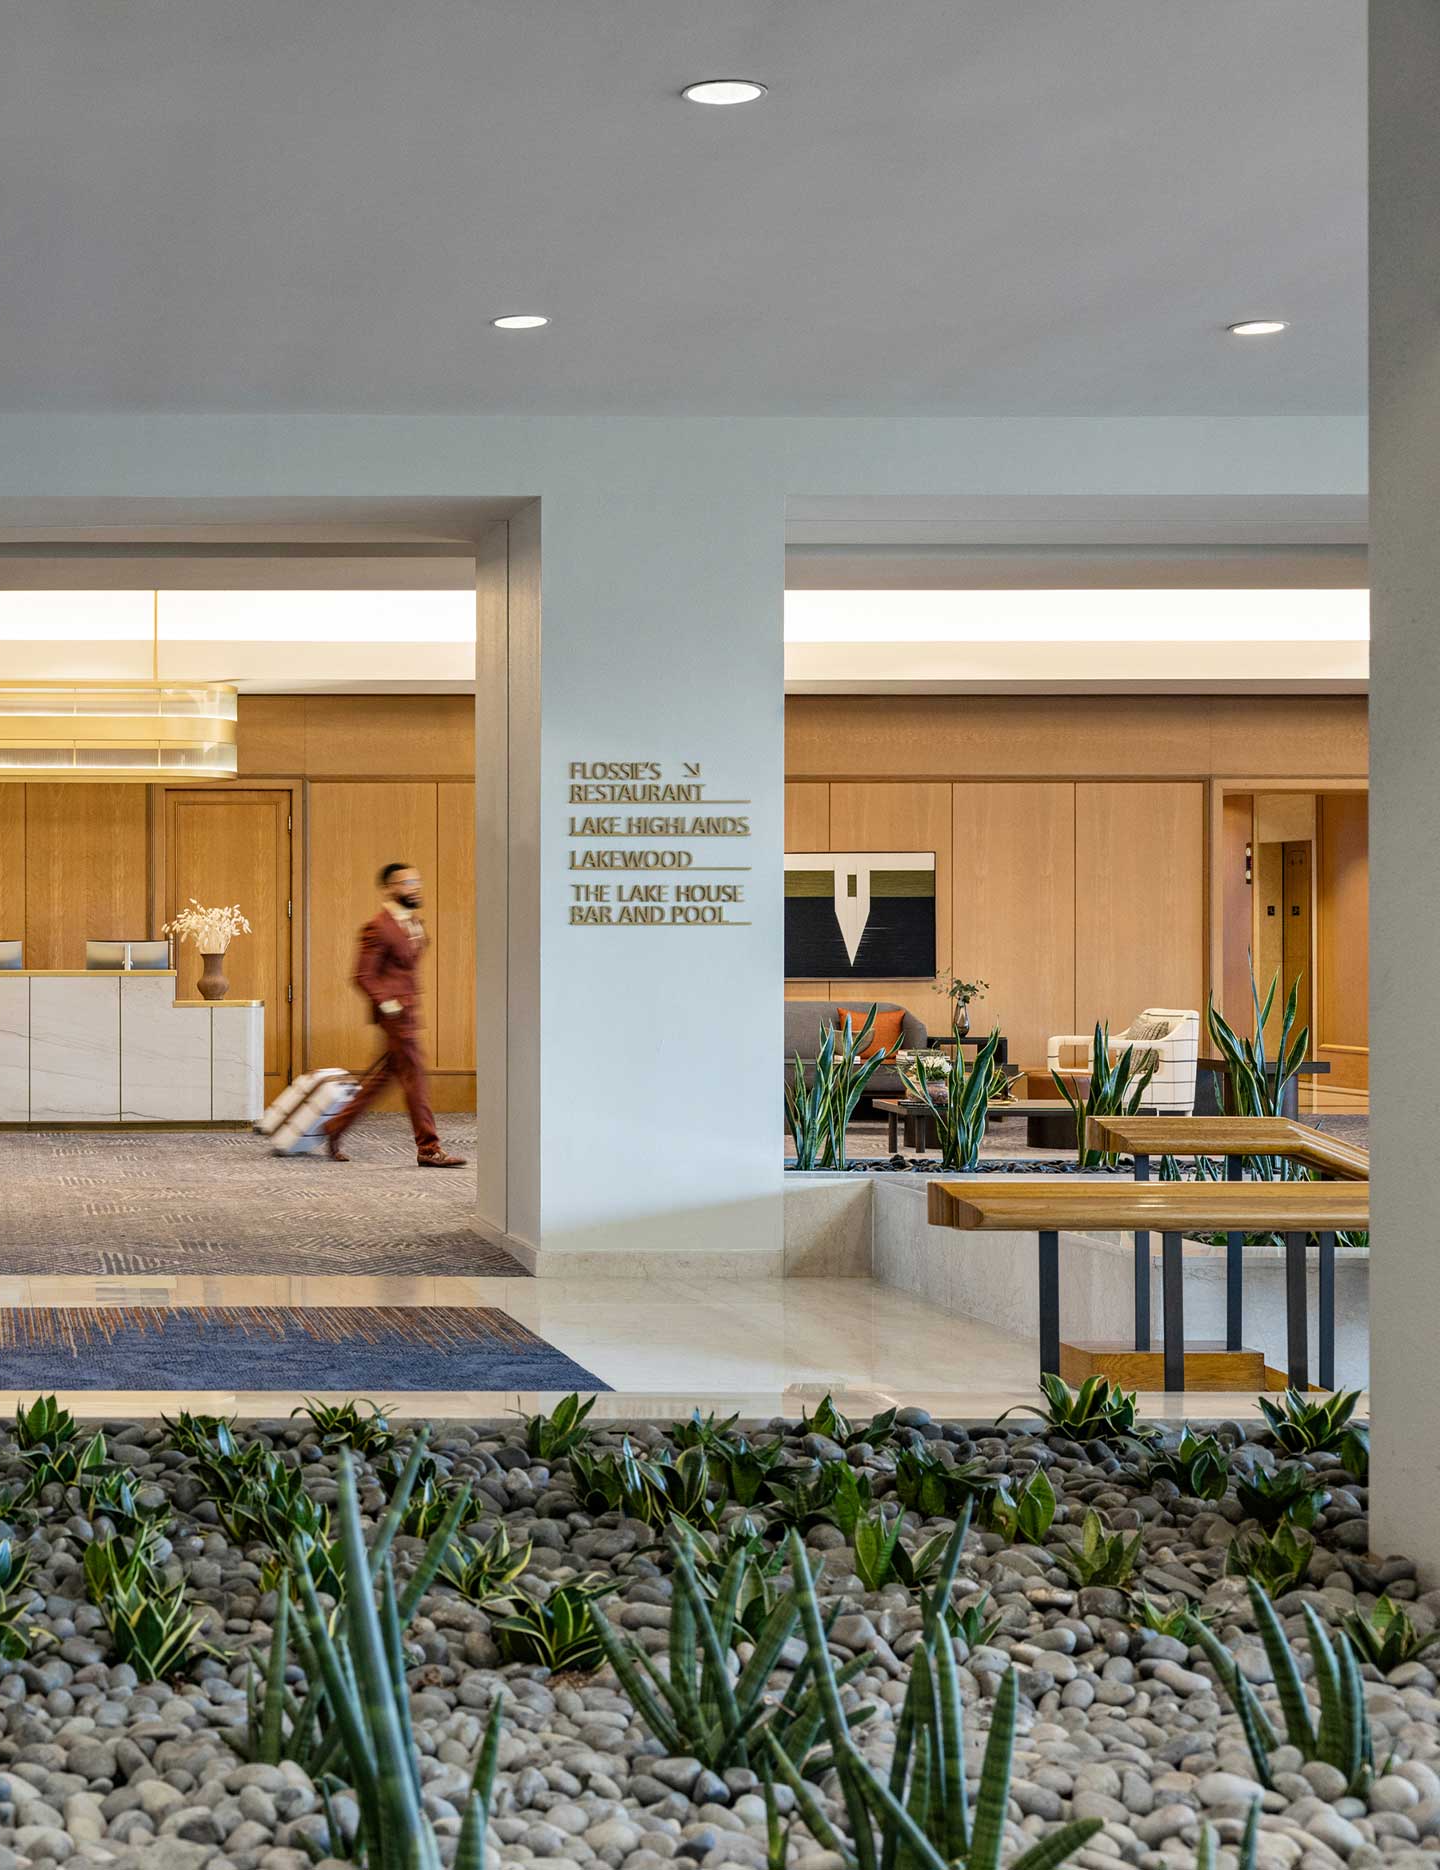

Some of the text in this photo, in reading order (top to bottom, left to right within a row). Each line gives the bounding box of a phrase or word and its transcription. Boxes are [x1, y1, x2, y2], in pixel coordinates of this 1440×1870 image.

[570, 762, 661, 780] FLOSSIE'S
[570, 784, 706, 801] RESTAURANT
[570, 817, 750, 834] LAKE HIGHLANDS
[570, 851, 693, 868] LAKEWOOD
[571, 885, 744, 902] THE LAKE HOUSE
[570, 906, 729, 923] BAR AND POOL
